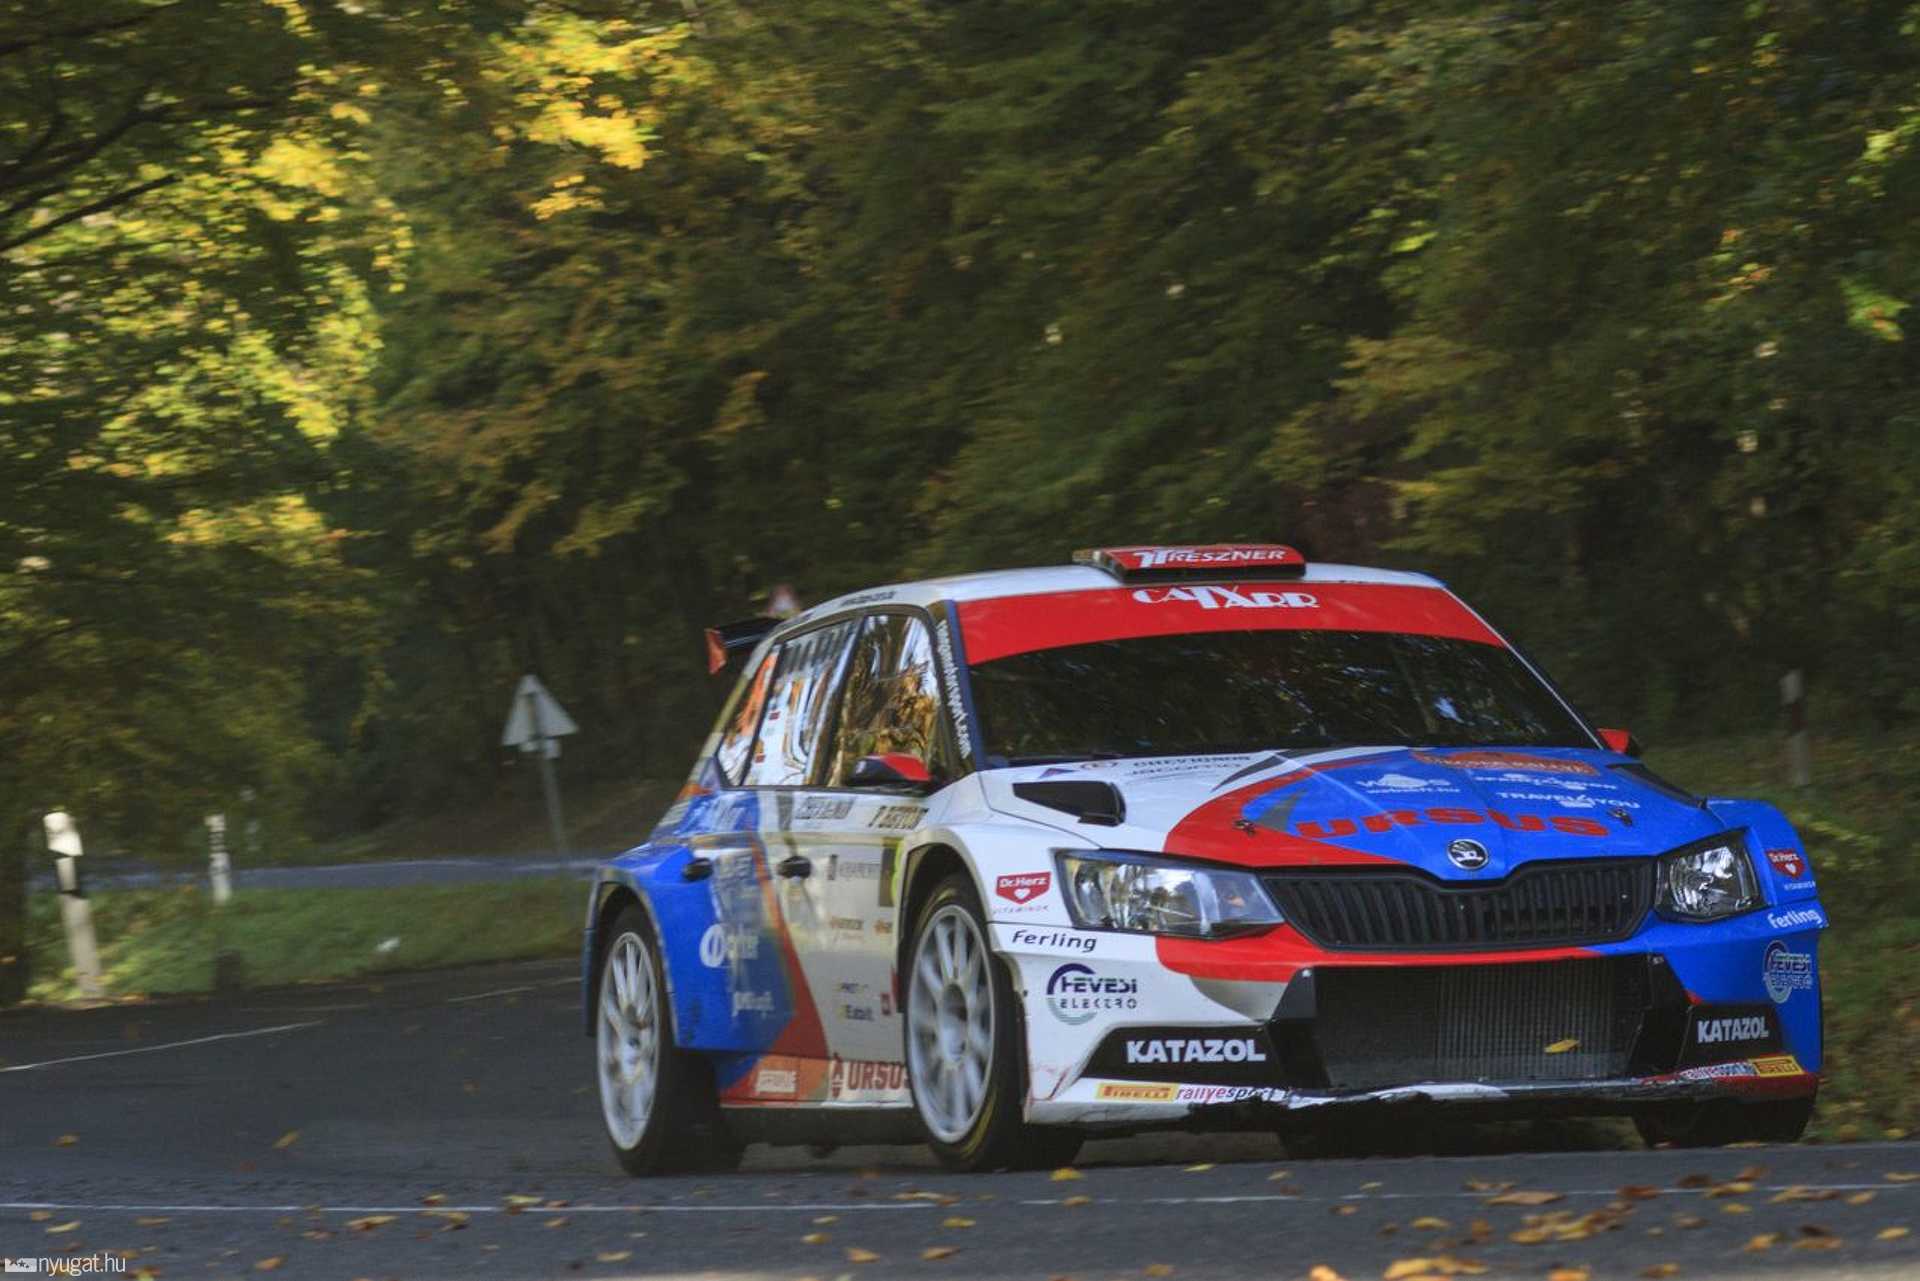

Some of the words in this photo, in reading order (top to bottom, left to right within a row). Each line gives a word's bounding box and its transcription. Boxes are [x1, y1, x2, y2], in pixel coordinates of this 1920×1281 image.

[1295, 808, 1609, 837] URSUS
[1767, 908, 1823, 930] Ferling
[1011, 929, 1097, 953] Ferling
[1697, 1017, 1769, 1043] KATAZOL
[1125, 1039, 1267, 1063] KATAZOL
[847, 1061, 910, 1091] URSU
[1102, 1085, 1171, 1100] PIRELLI
